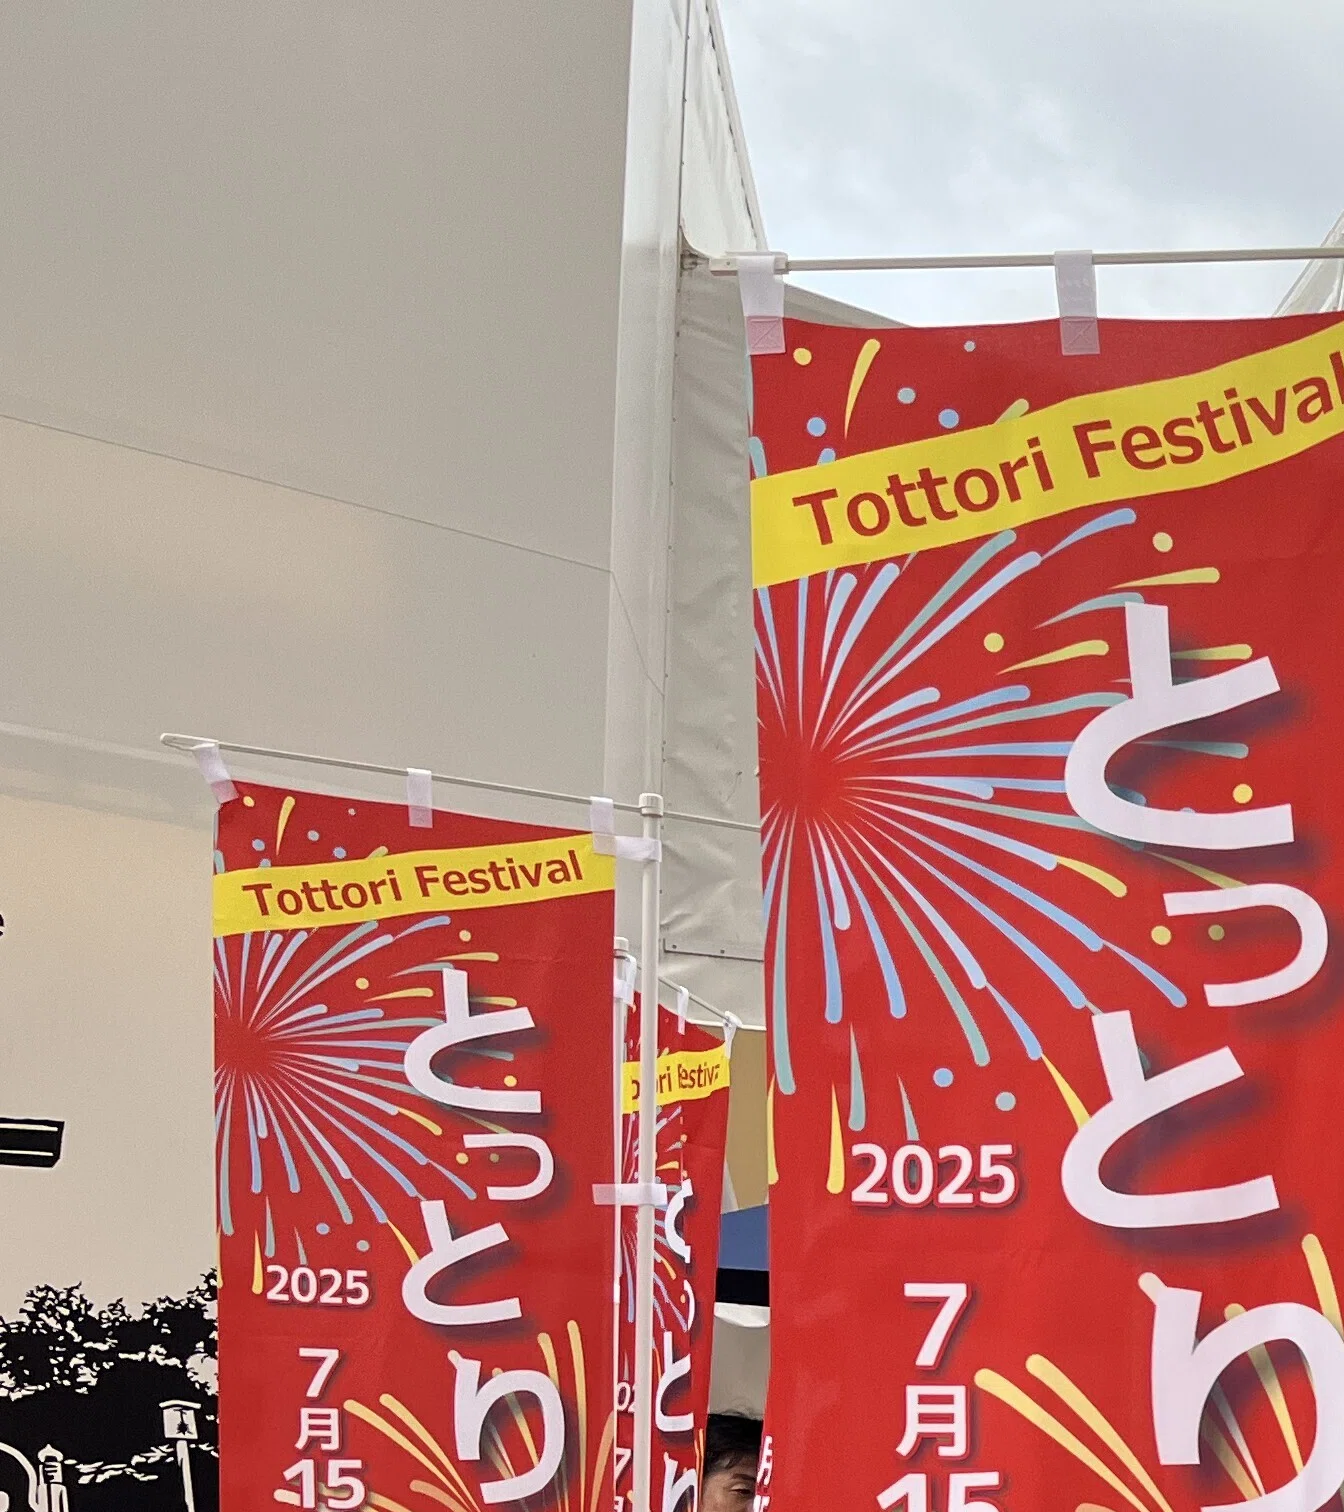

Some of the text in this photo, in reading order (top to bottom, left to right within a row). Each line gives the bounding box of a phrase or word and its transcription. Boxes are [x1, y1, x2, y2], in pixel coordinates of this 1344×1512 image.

[792, 437, 1055, 546] Tottori
[242, 849, 585, 919] Tottori Festival
[850, 1142, 1018, 1206] 2025
[266, 1264, 372, 1306] 2025
